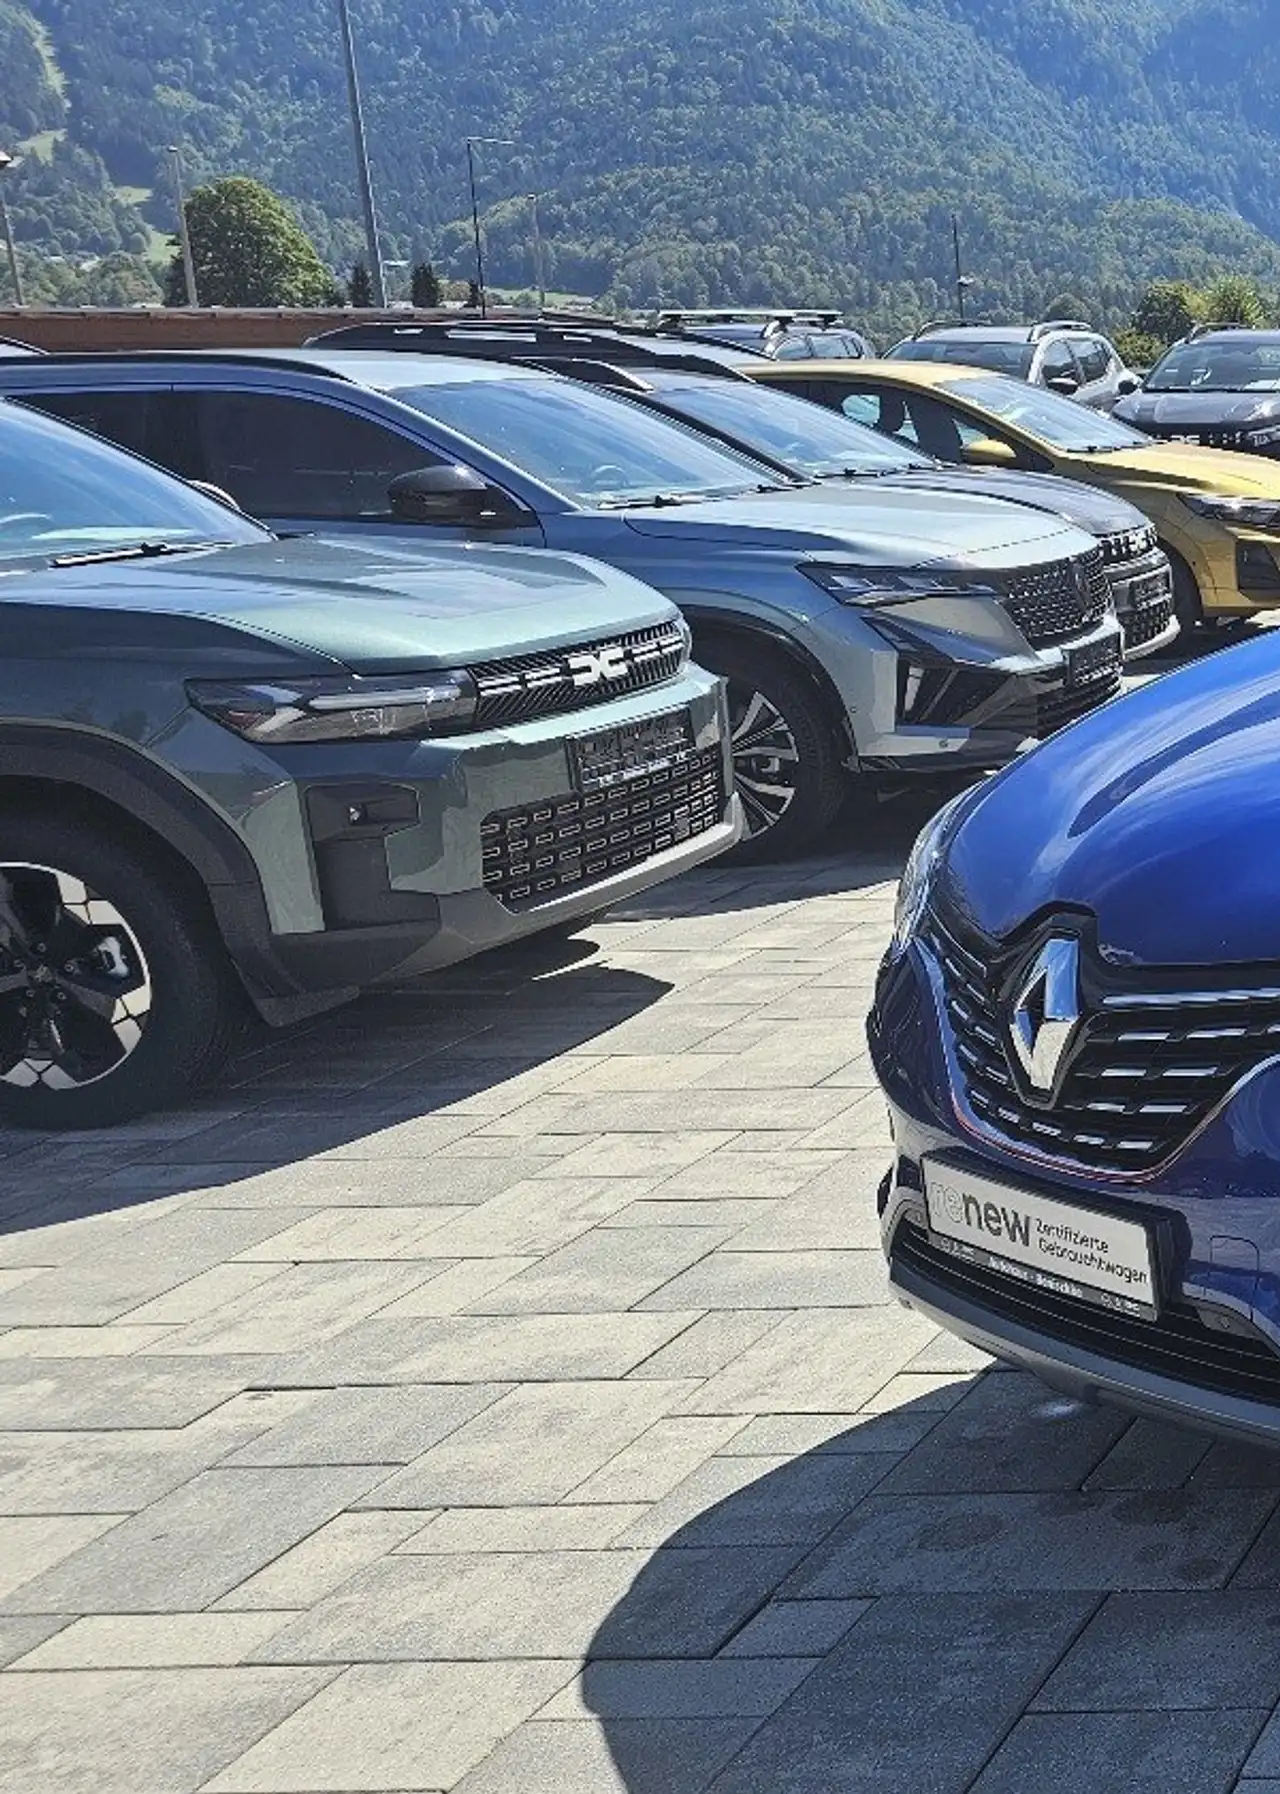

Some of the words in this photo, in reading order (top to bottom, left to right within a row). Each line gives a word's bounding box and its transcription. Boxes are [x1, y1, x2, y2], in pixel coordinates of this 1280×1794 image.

[930, 1181, 1031, 1247] renew
[1036, 1218, 1108, 1253] Zertifizierte
[1038, 1237, 1148, 1283] Gebrauchtwagen
